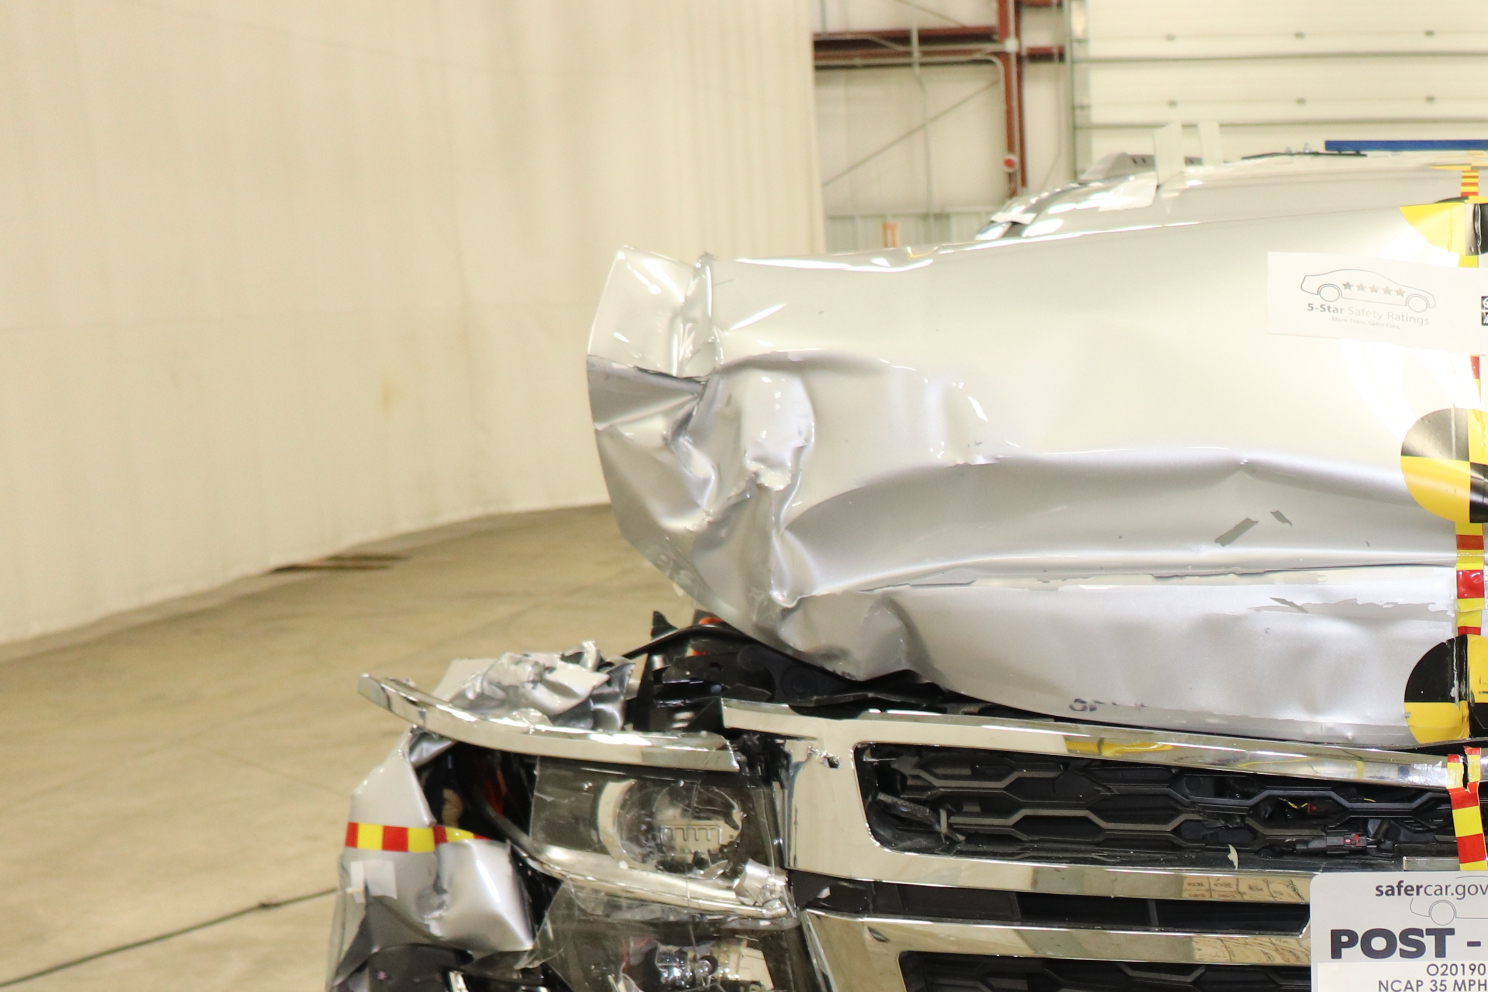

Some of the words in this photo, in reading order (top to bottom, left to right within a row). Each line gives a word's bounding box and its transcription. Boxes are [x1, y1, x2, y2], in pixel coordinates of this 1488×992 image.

[1307, 303, 1345, 314] 5-Star
[1348, 306, 1385, 320] Safety
[1387, 311, 1430, 326] Ratings
[1368, 320, 1385, 328] Safer
[1375, 880, 1488, 899] safercar.gov
[1330, 928, 1455, 959] POST
[1466, 940, 1482, 948] -
[1378, 980, 1424, 992] NCAP
[1429, 979, 1447, 992] 35
[1453, 979, 1487, 992] MPH
